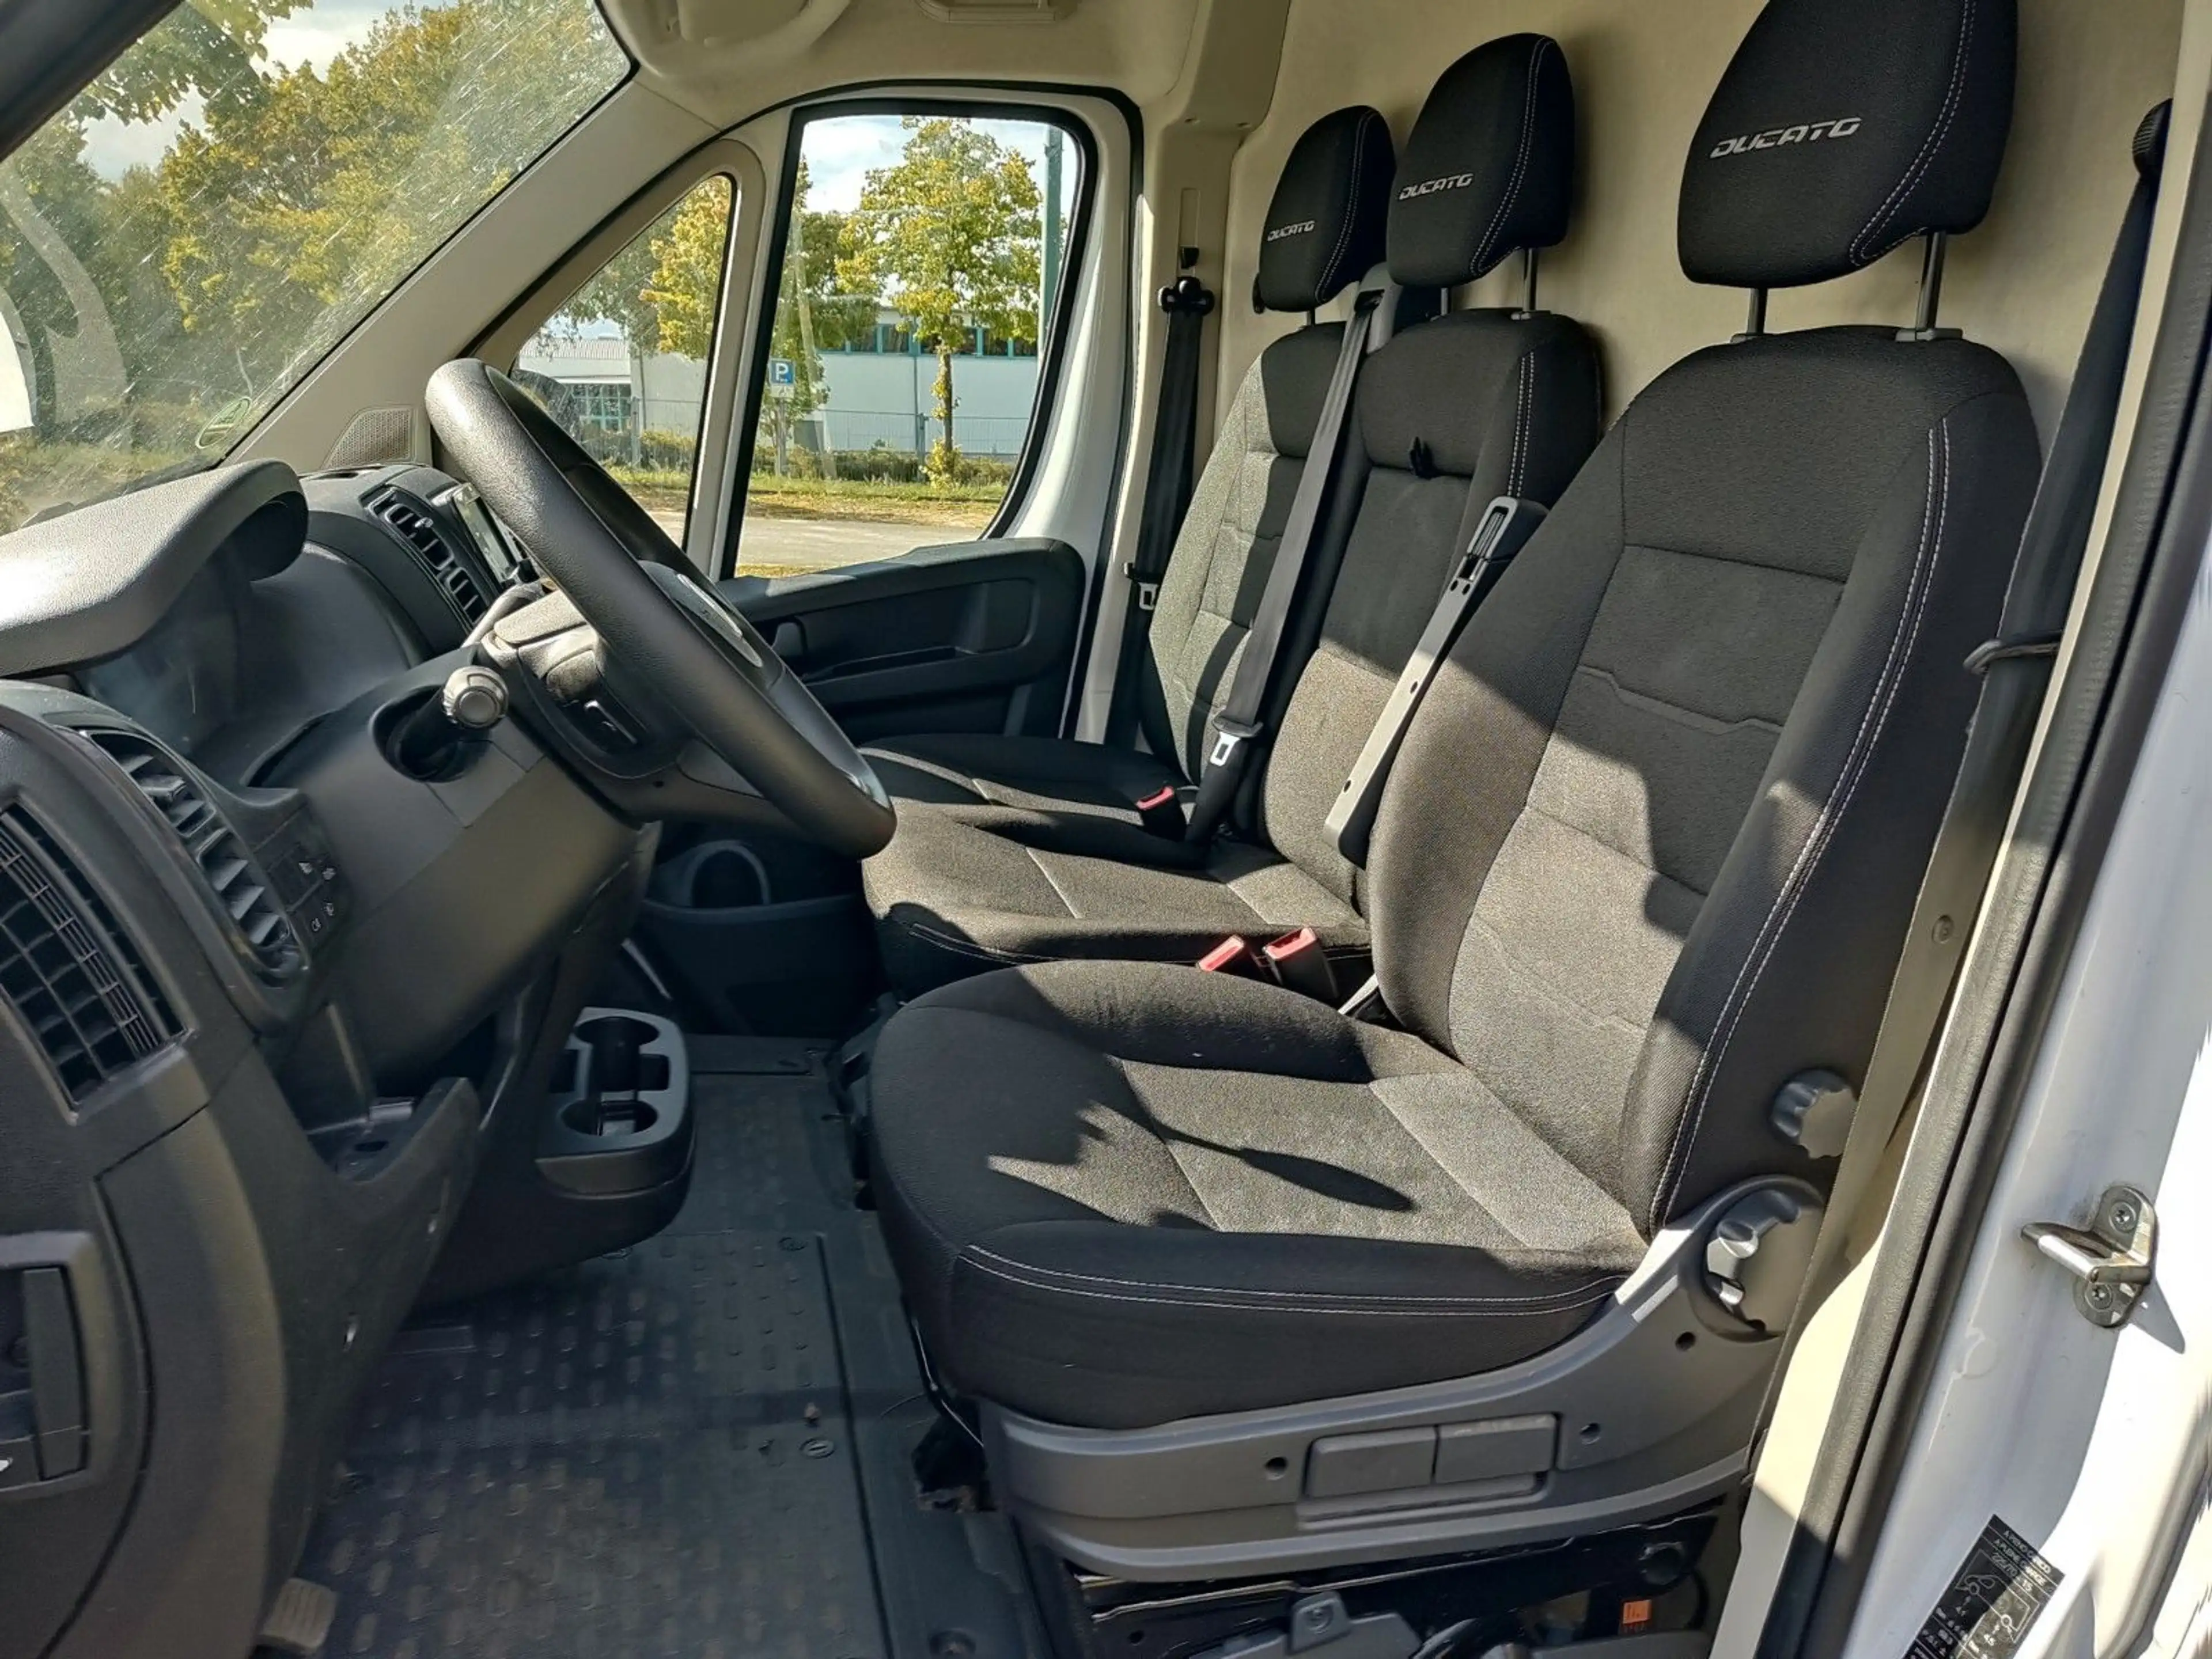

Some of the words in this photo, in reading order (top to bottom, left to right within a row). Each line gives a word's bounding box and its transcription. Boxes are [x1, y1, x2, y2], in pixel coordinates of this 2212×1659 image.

[1710, 117, 1862, 158] DUCATO
[1399, 173, 1474, 200] DUCATO
[1267, 220, 1315, 241] DUCATO
[775, 363, 789, 381] P
